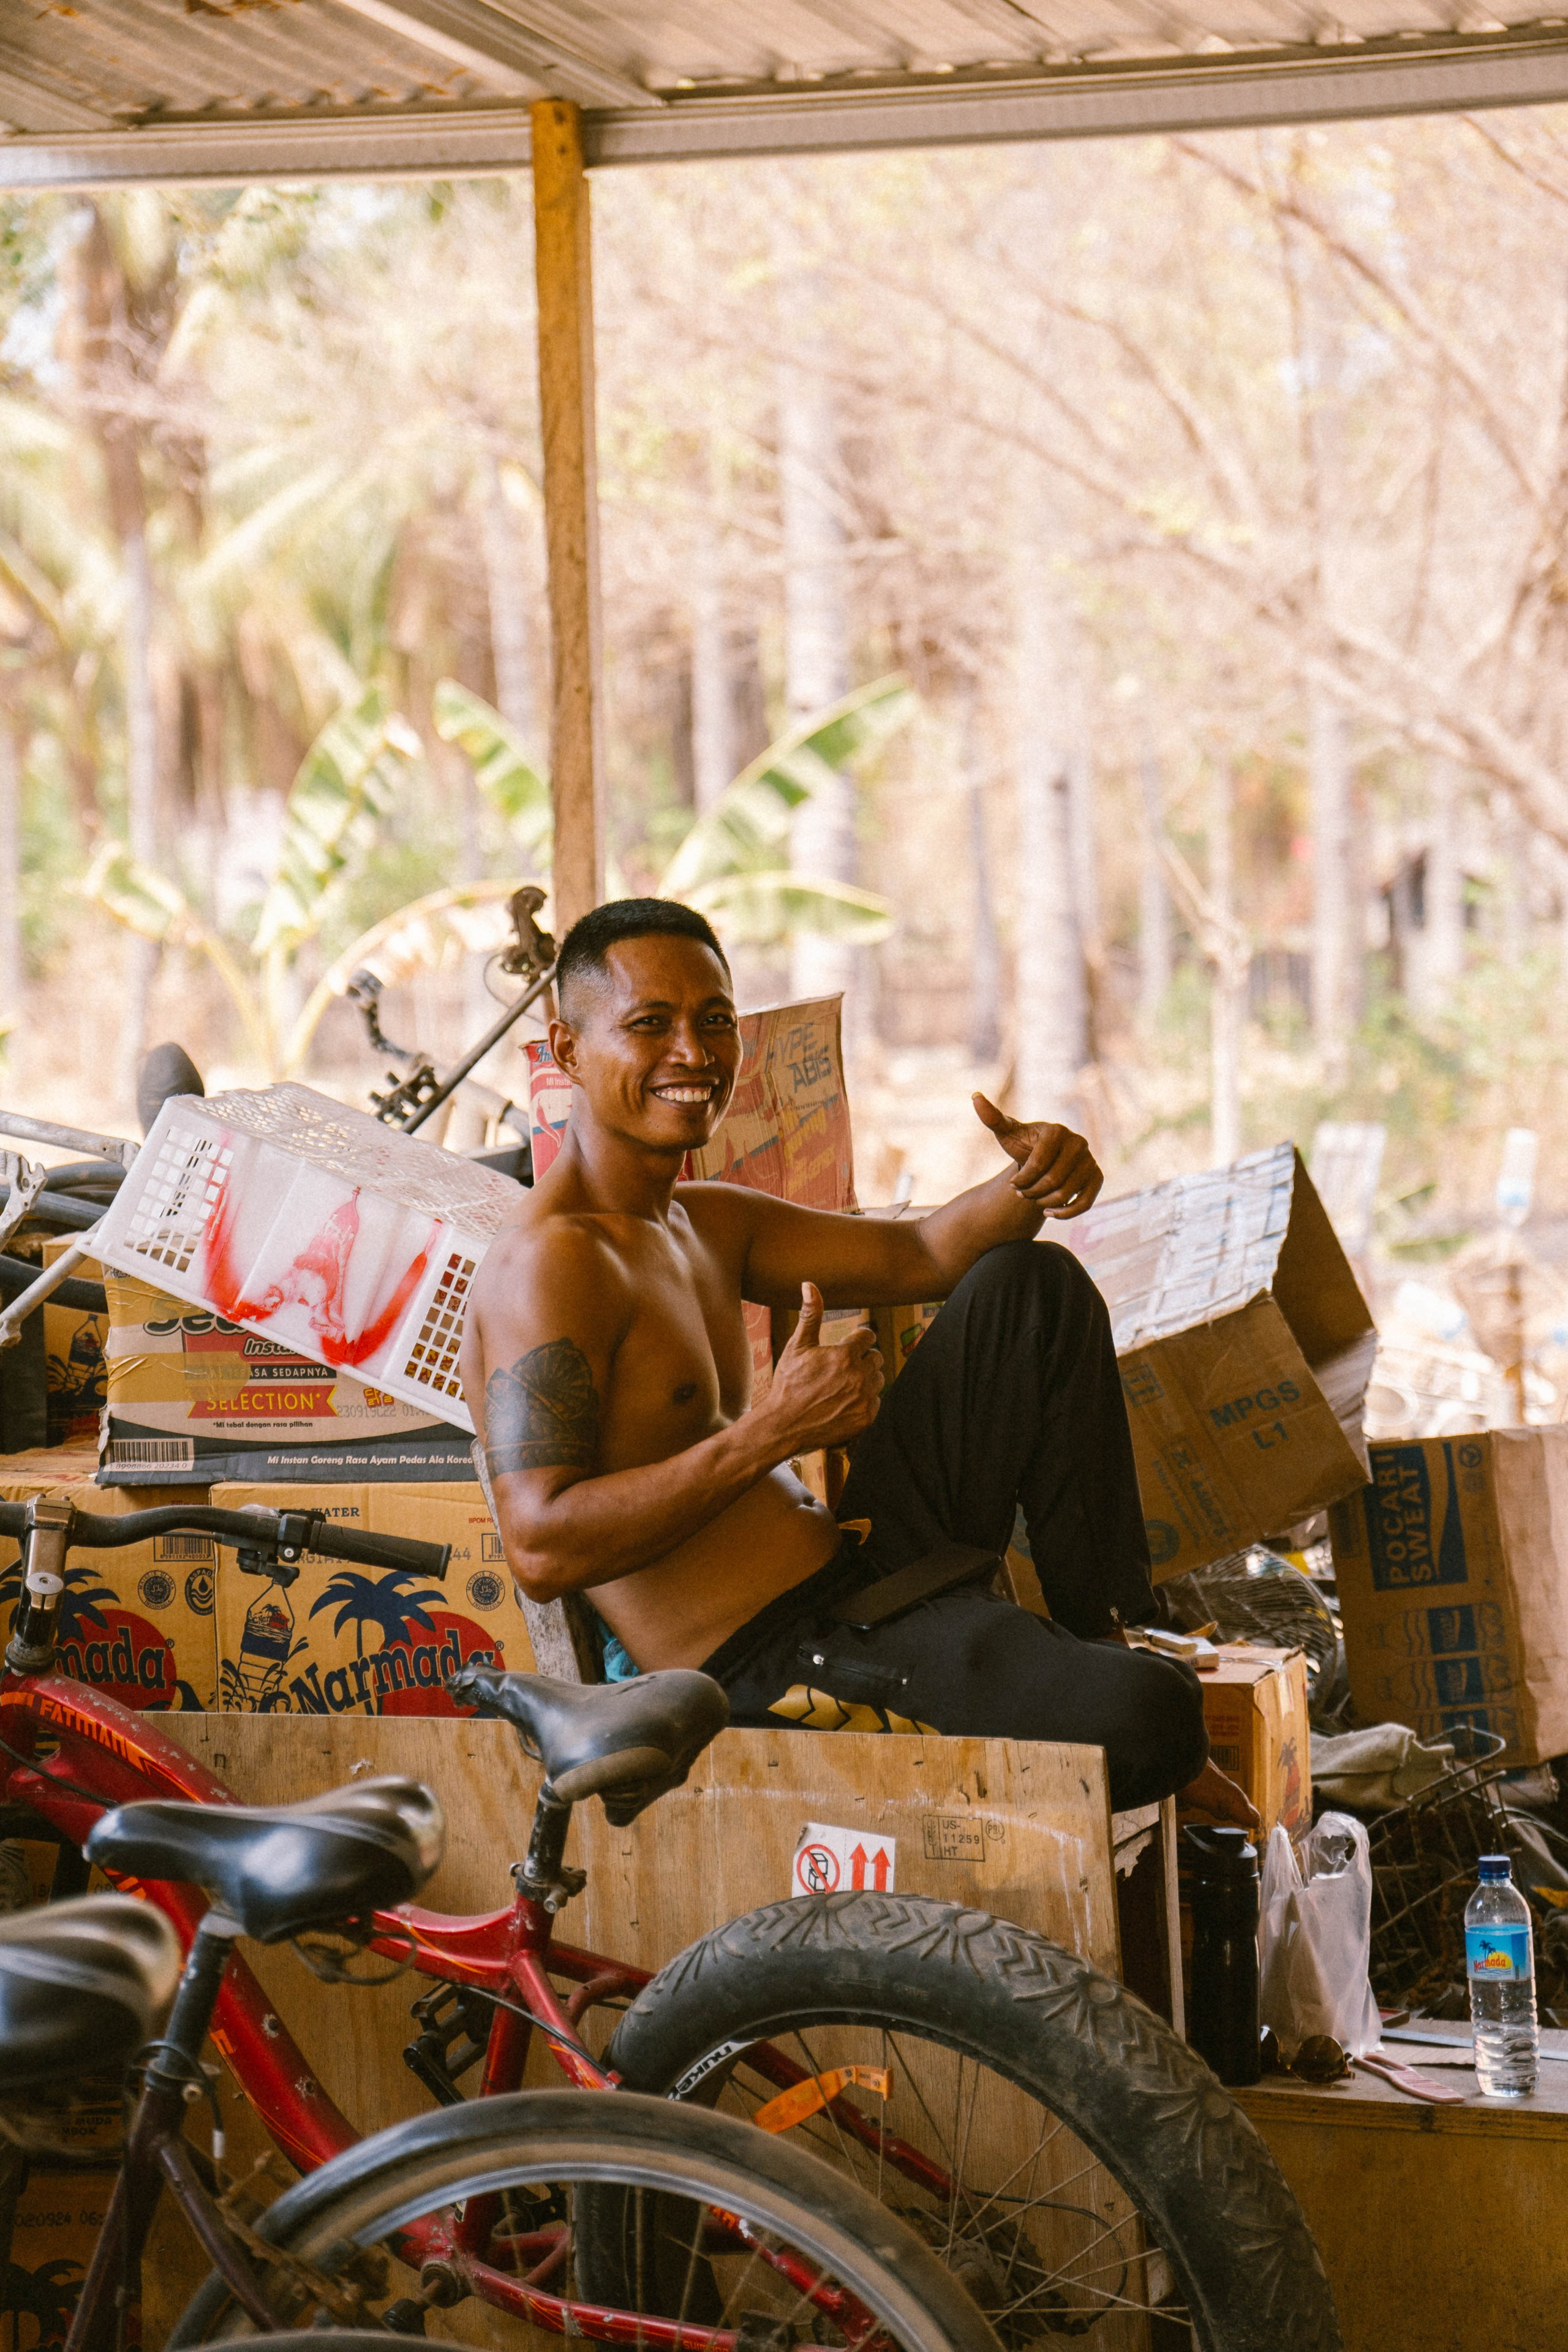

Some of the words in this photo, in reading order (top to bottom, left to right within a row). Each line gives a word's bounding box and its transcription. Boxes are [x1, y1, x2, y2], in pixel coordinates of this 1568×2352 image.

[273, 1367, 328, 1378] SEDAPNYA
[1209, 1381, 1300, 1431] MPGS
[1251, 1420, 1289, 1450] L1
[267, 1455, 277, 1464] Mi
[279, 1455, 308, 1464] Instan
[311, 1455, 343, 1466] Goreng
[345, 1455, 368, 1464] Rasa
[369, 1455, 397, 1466] Ayam
[399, 1455, 426, 1464] Pedas
[429, 1455, 444, 1464] Ala
[1374, 1454, 1410, 1584] POCARI
[1398, 1465, 1433, 1582] SWEAT
[472, 1600, 501, 1611] INDONESIA
[942, 1820, 960, 1830] US-
[943, 1833, 979, 1844] 11259
[944, 1846, 957, 1856] HT
[1473, 1954, 1506, 1973] Narmada
